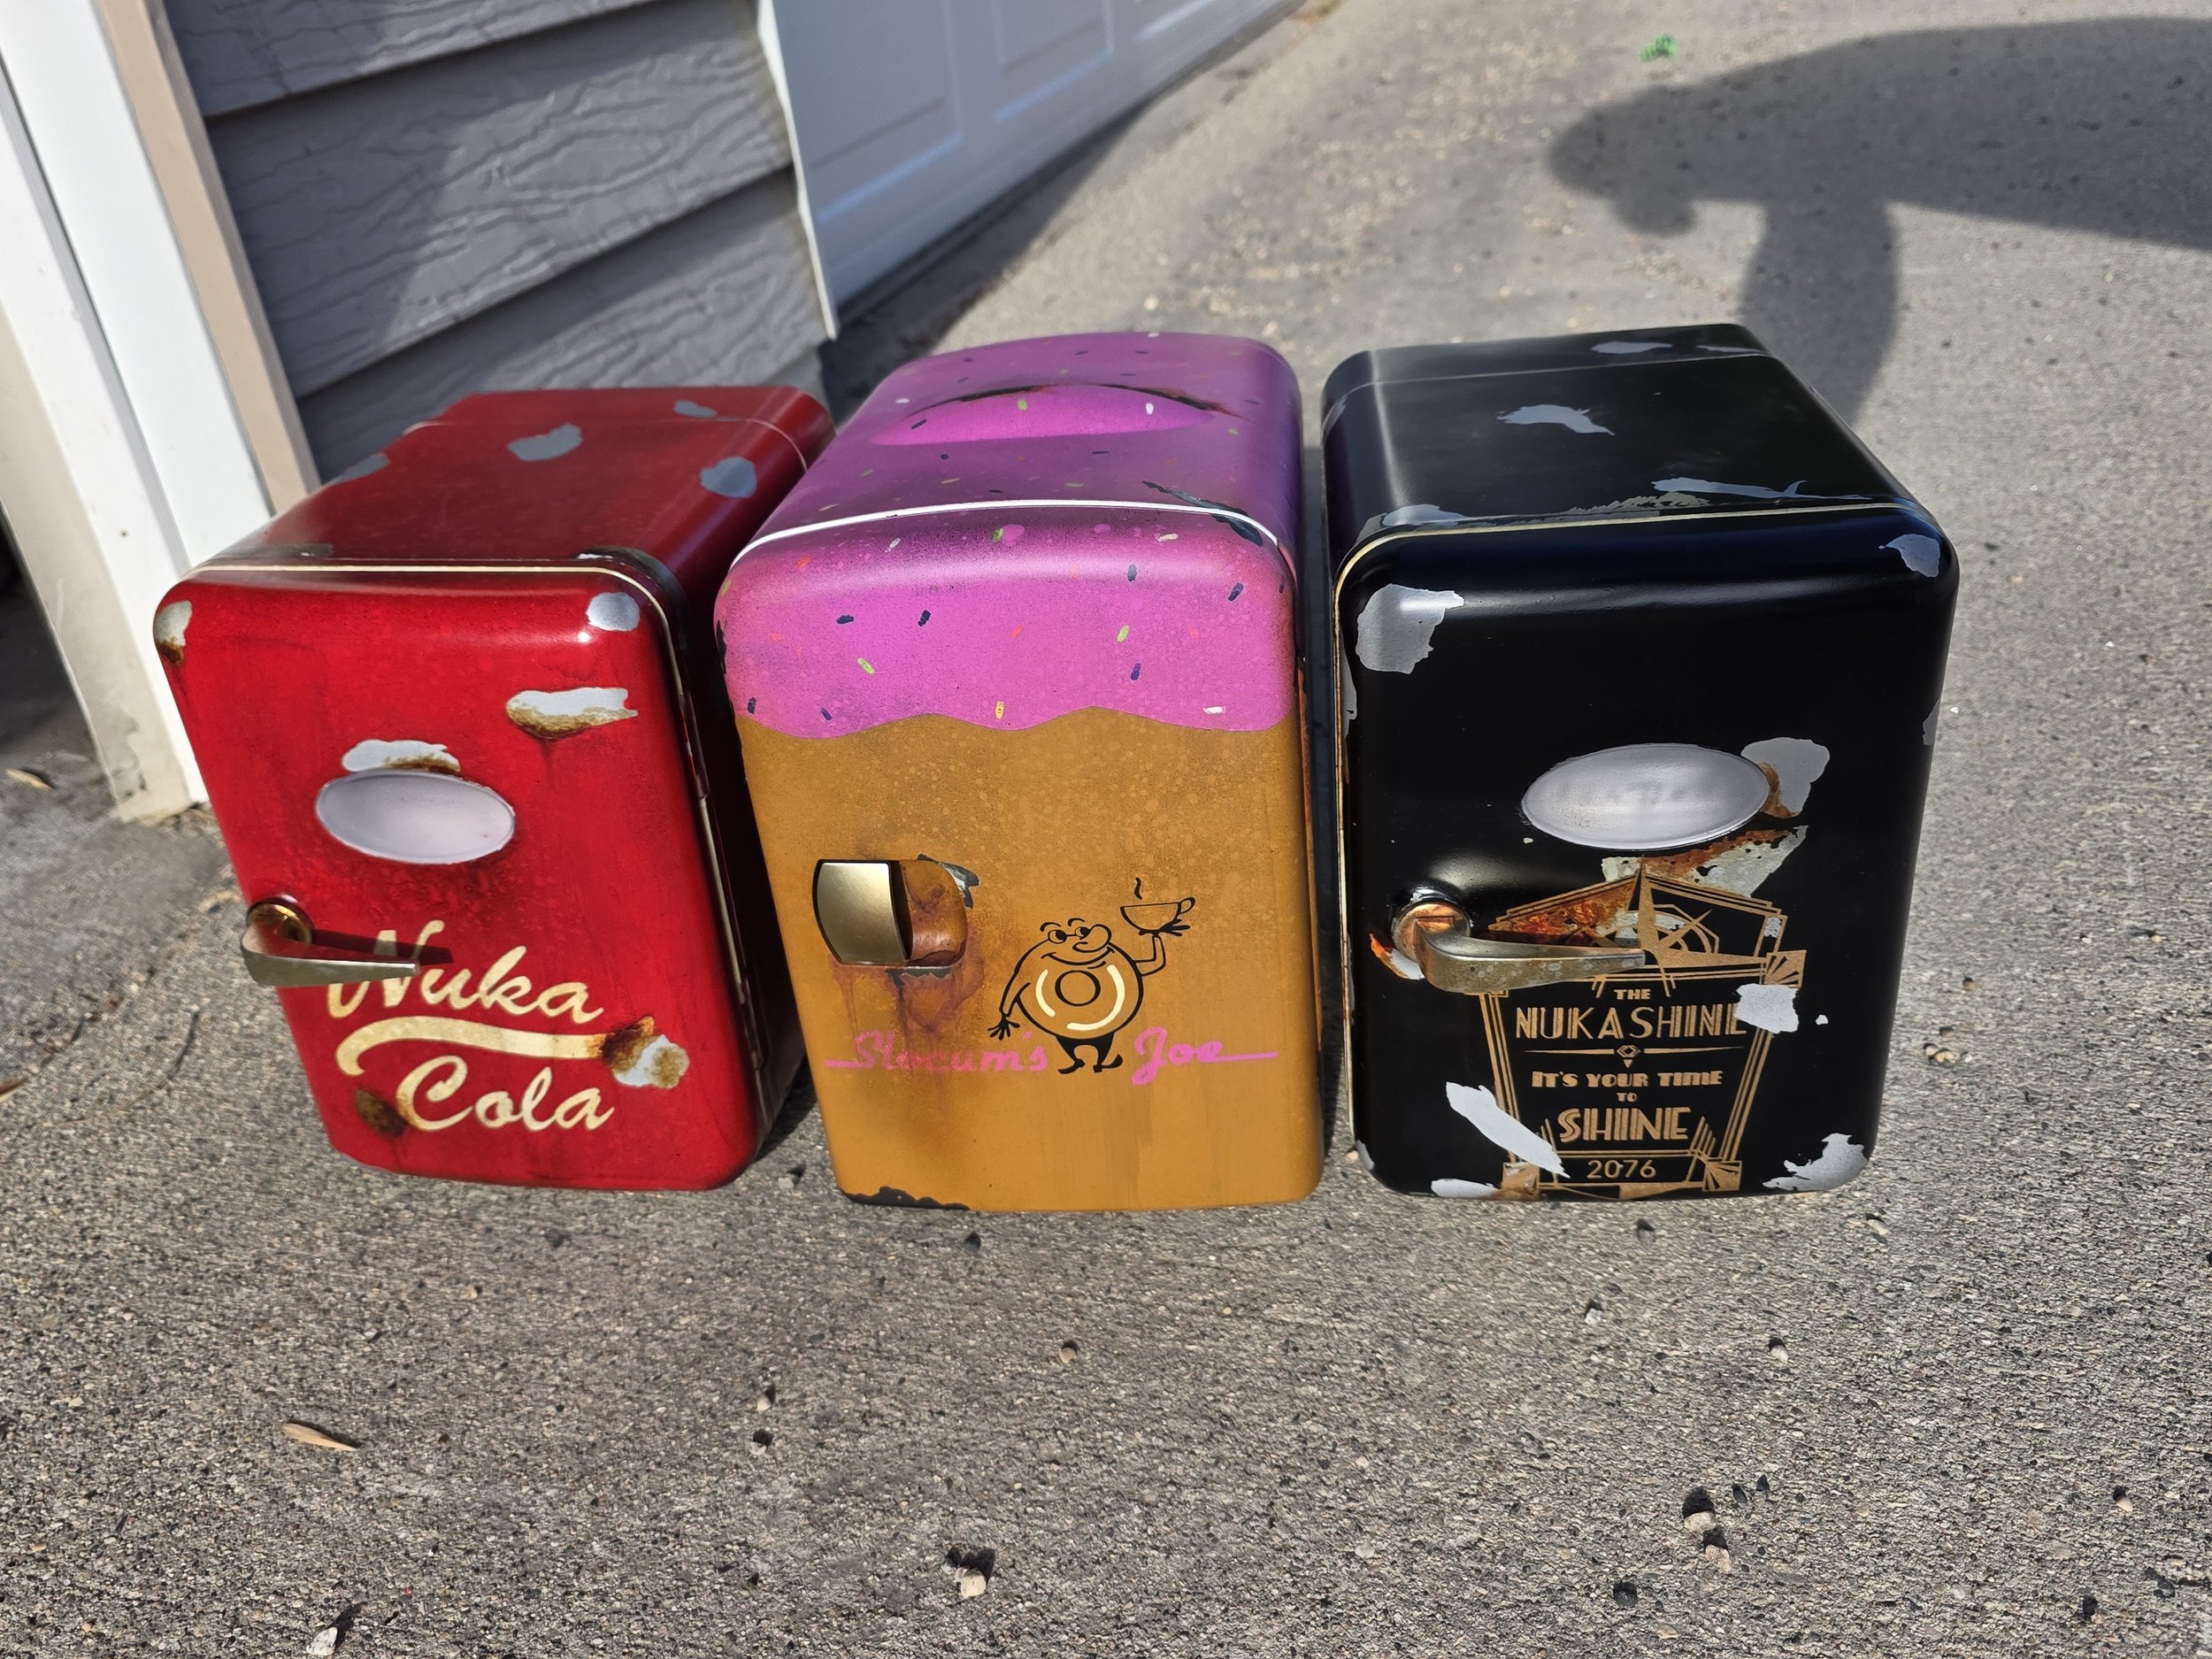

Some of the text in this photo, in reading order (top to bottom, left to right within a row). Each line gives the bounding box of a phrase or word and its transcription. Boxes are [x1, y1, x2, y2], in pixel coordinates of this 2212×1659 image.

[326, 919, 603, 1024] Nuka
[1614, 988, 1651, 1001] THE
[1132, 1026, 1279, 1086] Joe
[1532, 1070, 1724, 1087] IT'S YOUR TIME
[395, 1055, 614, 1132] Cola
[1616, 1092, 1638, 1102] TO
[1557, 1107, 1692, 1142] SHINE
[1586, 1159, 1656, 1179] 2076
